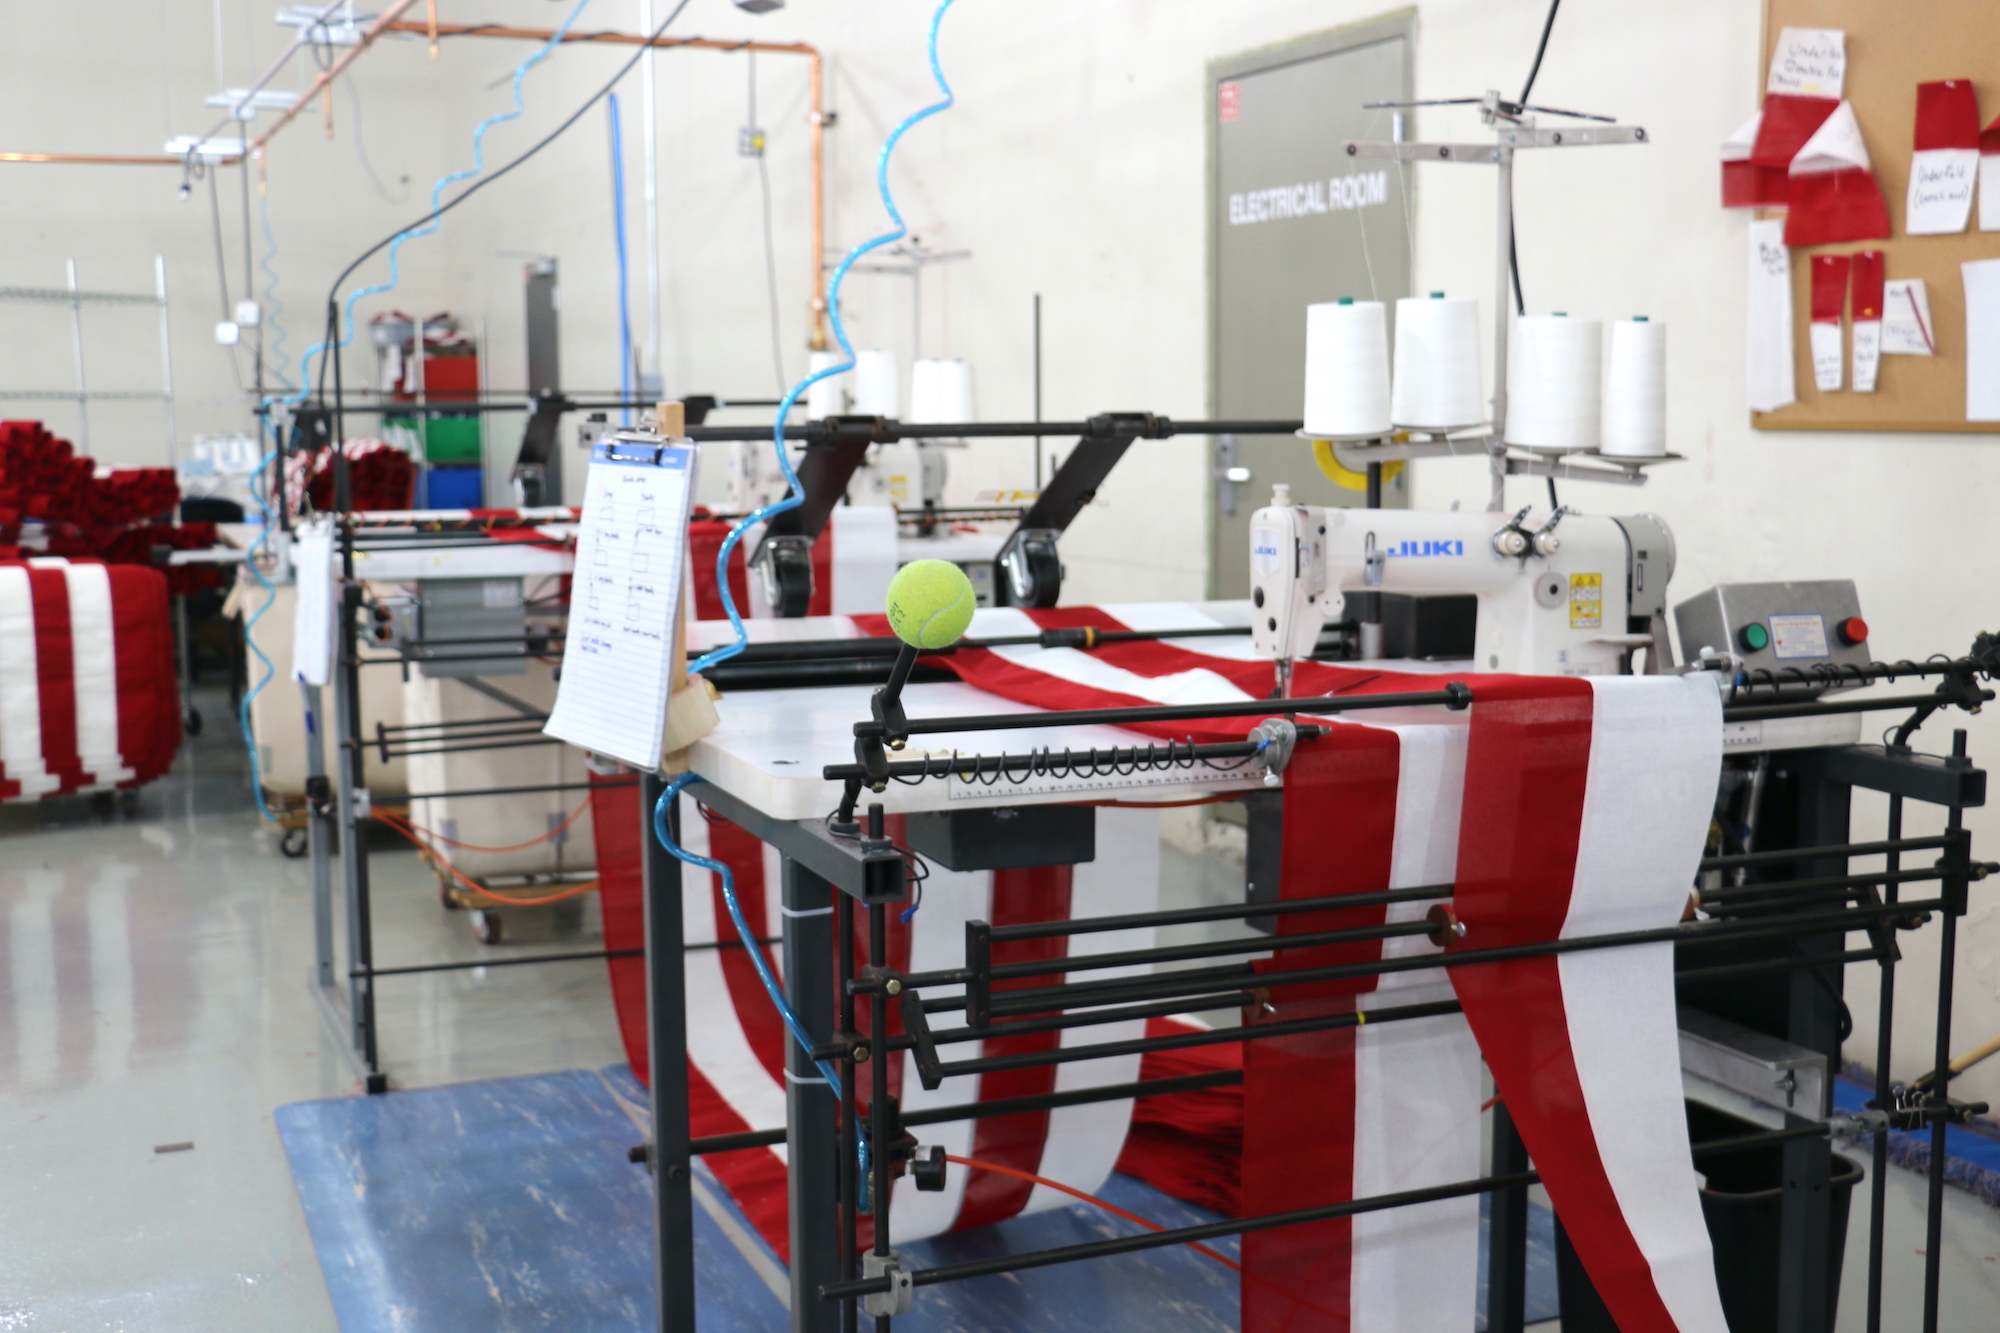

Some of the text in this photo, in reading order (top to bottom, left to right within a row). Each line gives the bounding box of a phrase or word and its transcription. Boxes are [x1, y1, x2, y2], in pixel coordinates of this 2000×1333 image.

[1229, 170, 1387, 225] ELECTRICAL ROOM
[1254, 546, 1277, 556] JUKI
[1387, 541, 1463, 557] JUKI
